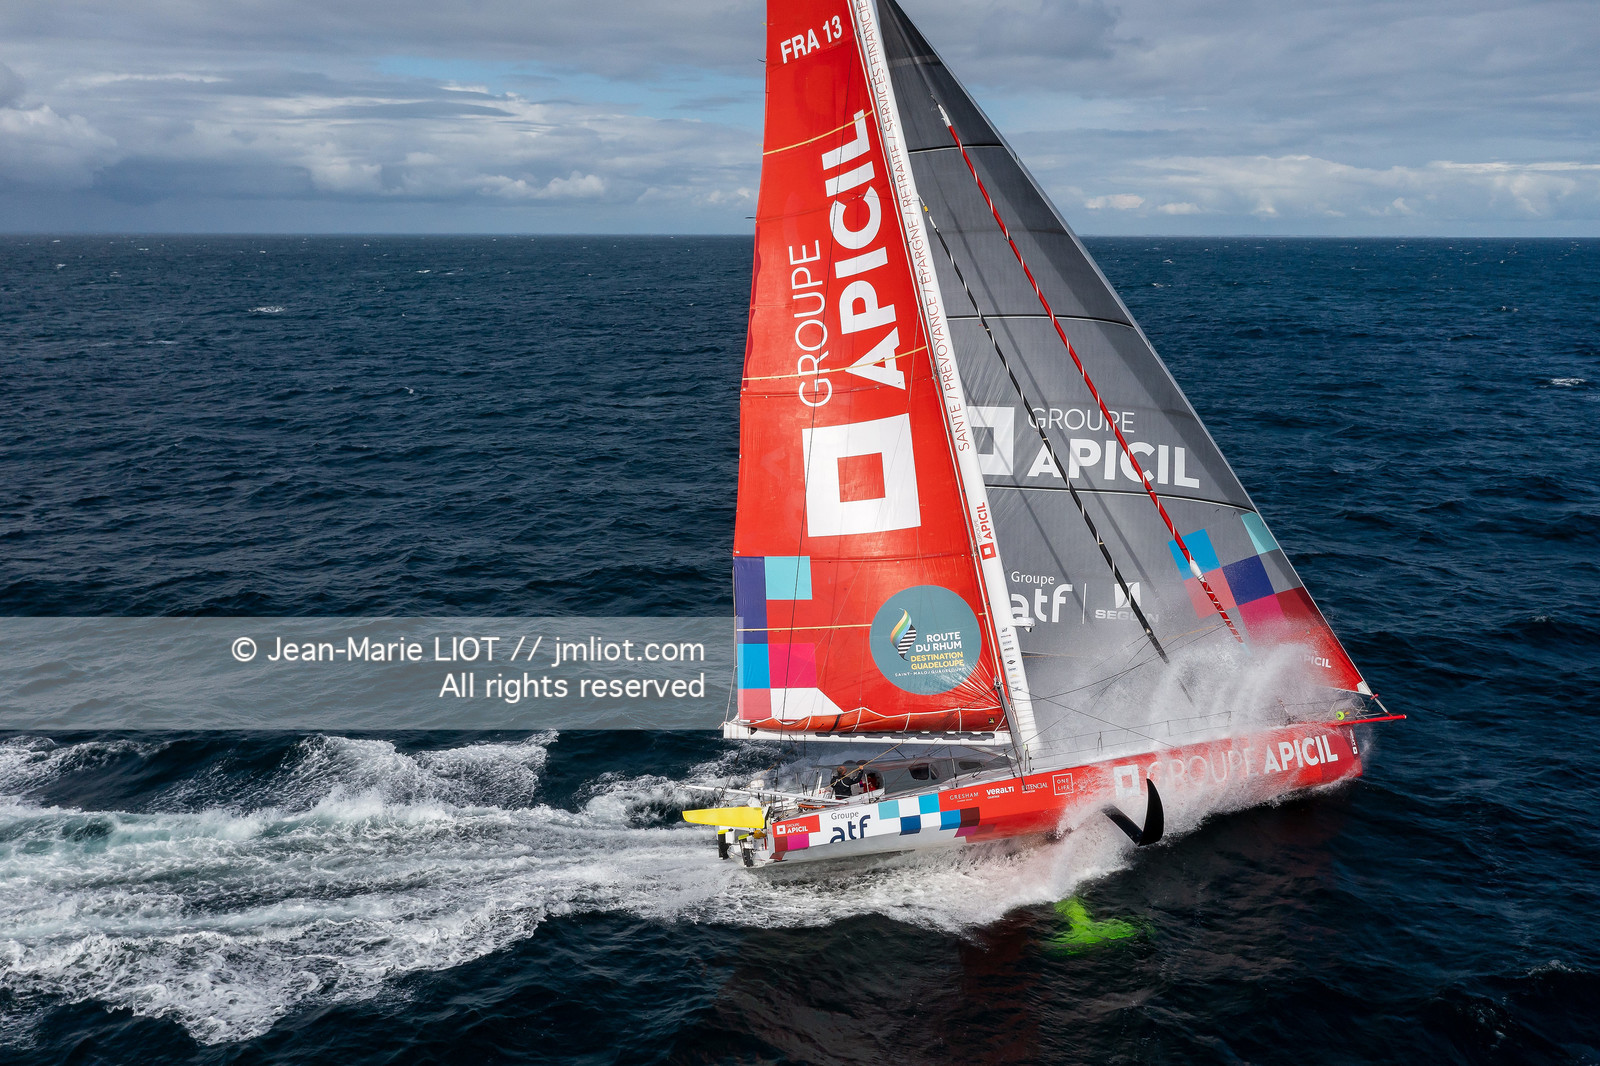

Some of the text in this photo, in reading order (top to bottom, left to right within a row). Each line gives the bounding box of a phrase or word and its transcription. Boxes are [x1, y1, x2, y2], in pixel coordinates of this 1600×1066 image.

[780, 15, 844, 65] FRA 13
[872, 67, 894, 132] SERVICES
[889, 144, 912, 208] RETRAITE
[821, 109, 906, 390] APICIL
[788, 239, 833, 408] GROUPE
[1028, 407, 1135, 433] GROUPE
[1027, 438, 1200, 489] APICIL
[976, 501, 993, 540] APICIL
[1011, 571, 1055, 587] Groupe
[1011, 583, 1073, 623] atf
[1094, 608, 1160, 624] SEGUN
[915, 641, 962, 653] DU RHUM
[926, 631, 961, 643] ROUTE
[910, 651, 964, 662] DESTINATION
[911, 659, 965, 670] GUADELOUPE
[1299, 654, 1332, 668] PICIL
[1264, 734, 1339, 774] APICIL
[830, 814, 871, 844] atf
[831, 811, 860, 820] Groupe
[787, 826, 808, 834] APICIL
